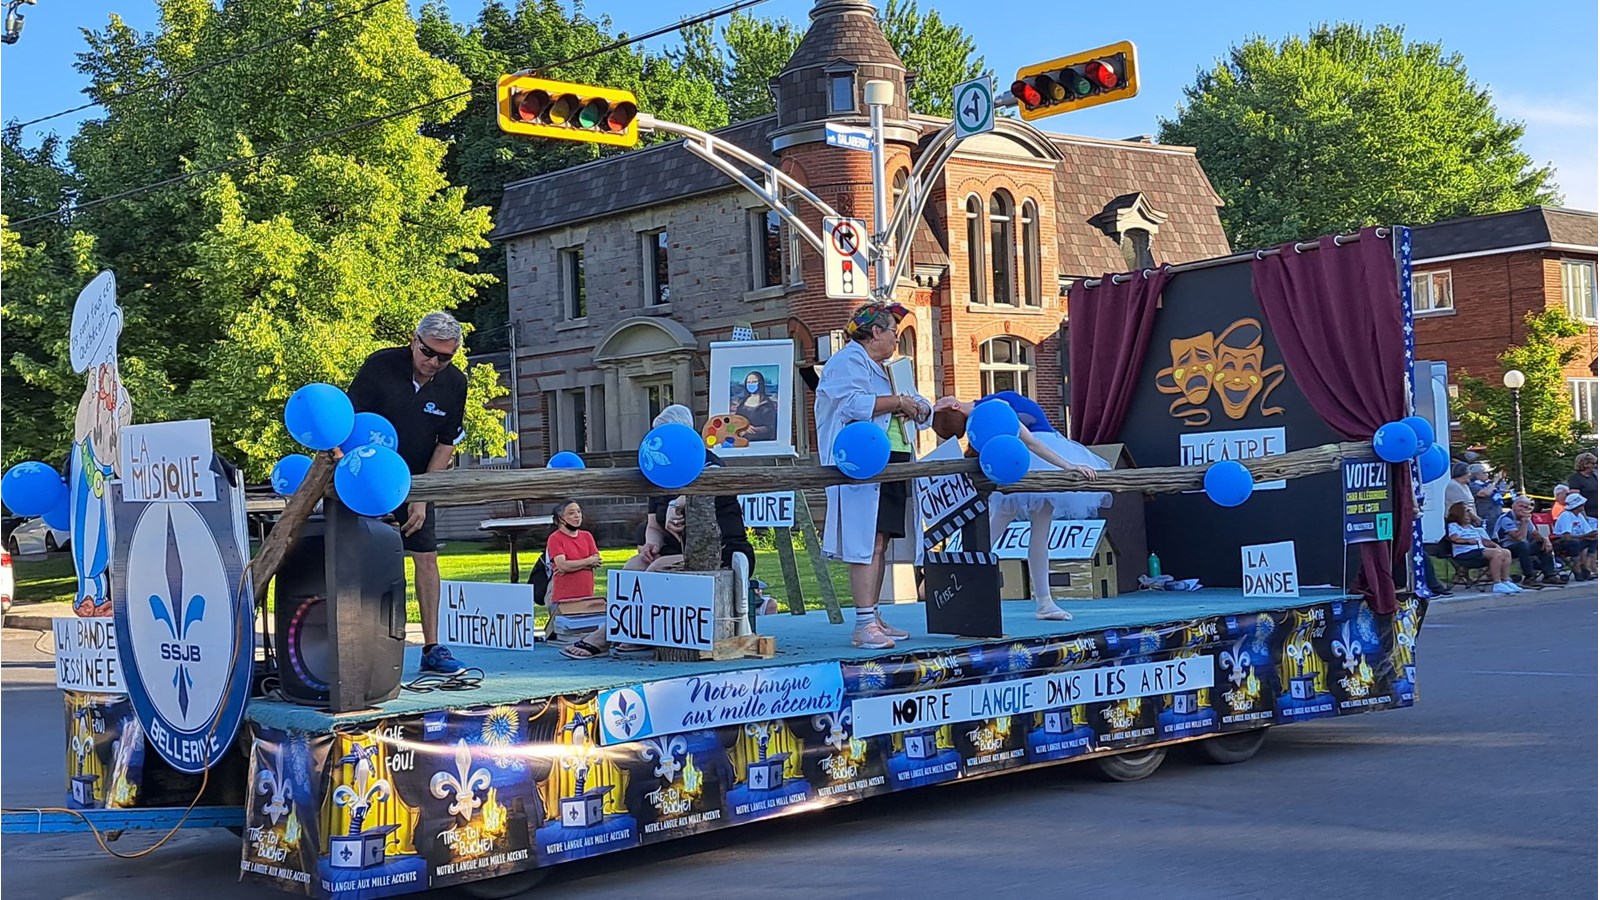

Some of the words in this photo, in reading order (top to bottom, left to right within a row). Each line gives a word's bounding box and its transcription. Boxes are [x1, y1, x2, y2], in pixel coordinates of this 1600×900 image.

[130, 433, 150, 463] LA
[1345, 462, 1387, 489] VOTEZ!
[1247, 550, 1269, 568] LA
[616, 573, 644, 603] LA
[950, 573, 963, 591] 2
[1244, 572, 1295, 595] DANSE
[448, 584, 466, 610] LA
[57, 622, 72, 652] LA
[77, 621, 116, 650] BANDE
[447, 608, 533, 649] LITTÉRATURE
[610, 603, 712, 645] SCULPTURE
[161, 643, 201, 662] SSJB
[60, 652, 117, 687] DESSINÉE
[687, 677, 749, 704] Notre
[752, 674, 812, 700] langue
[893, 692, 952, 726] NOTRE
[971, 682, 1034, 717] LANGUE
[1047, 676, 1081, 705] DANS
[1095, 669, 1126, 697] LES
[1141, 661, 1187, 693] ARTS
[682, 705, 717, 727] aux
[720, 696, 768, 720] mille
[771, 688, 842, 714] accents!
[150, 717, 220, 763] BELLERIVE
[385, 750, 415, 772] FOU!
[546, 842, 563, 854] NOTRE
[563, 838, 583, 851] LANGUE
[584, 836, 594, 847] AUX
[594, 833, 609, 844] MILLE
[610, 828, 630, 842] ACCENTS
[436, 864, 456, 876] NOTRE
[456, 859, 477, 872] LANGUE
[478, 857, 490, 867] AUX
[490, 854, 506, 865] MILLE
[506, 849, 528, 862] ACCENTS
[331, 880, 356, 892] LANGUE
[357, 878, 370, 889] AUX
[371, 875, 390, 887] MILLE
[391, 871, 417, 884] ACCENTS
